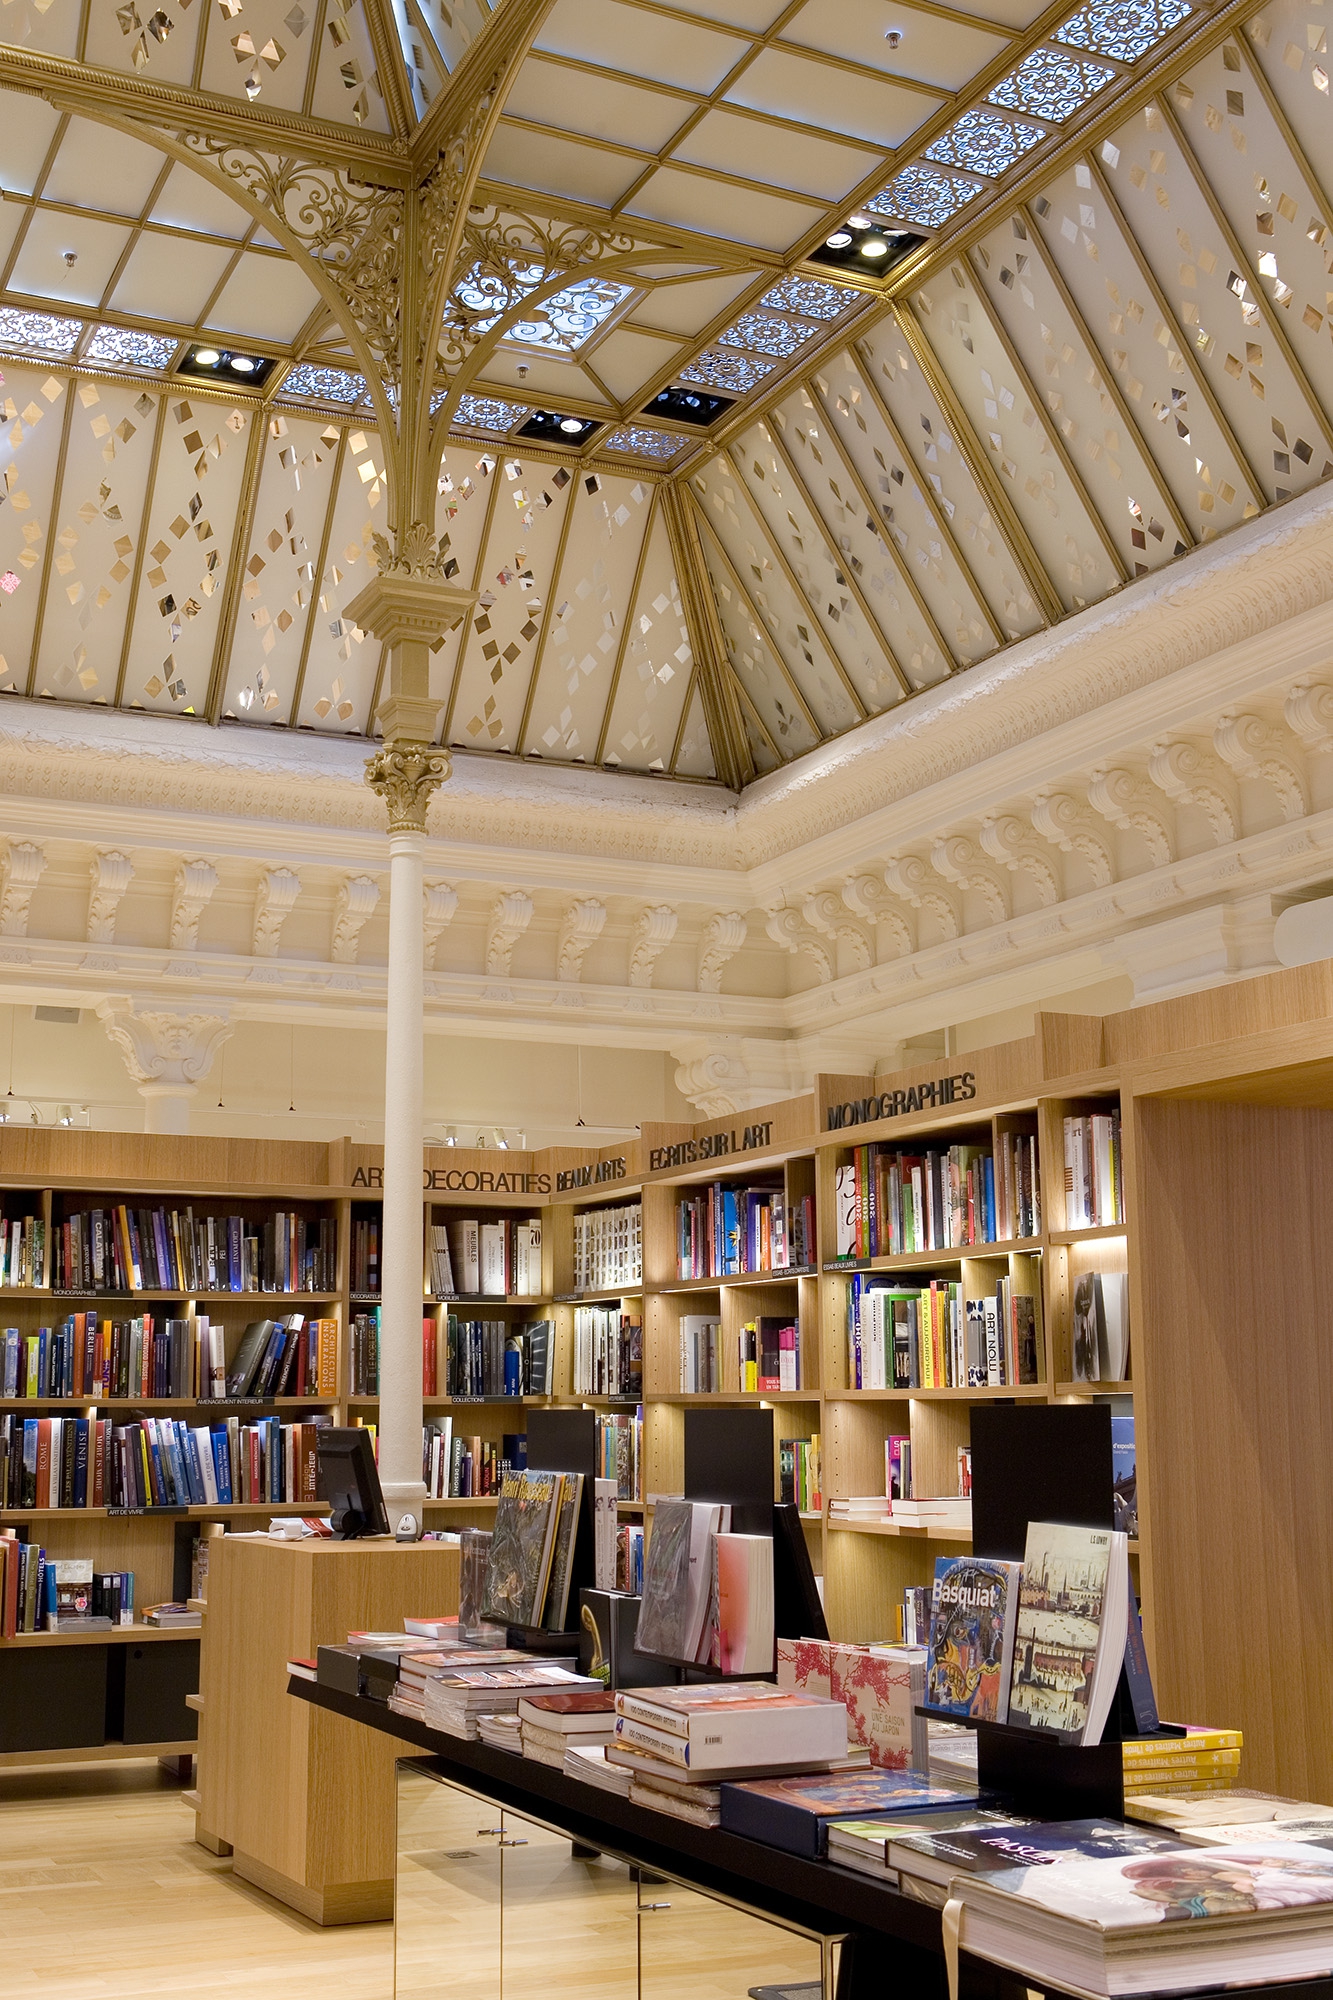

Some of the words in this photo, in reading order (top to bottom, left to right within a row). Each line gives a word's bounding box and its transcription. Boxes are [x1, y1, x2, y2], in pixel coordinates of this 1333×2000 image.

[827, 1072, 976, 1131] MONOGRAPHIES
[650, 1139, 697, 1171] ECRITS
[699, 1132, 729, 1159] SUR
[731, 1130, 741, 1154] L
[742, 1121, 773, 1151] ART
[557, 1165, 593, 1192] BEAUX
[595, 1157, 626, 1183] ARTS
[530, 1229, 541, 1246] 70
[95, 1222, 104, 1278] CALATRAVA
[53, 1289, 97, 1297] MONOGRAPHIES
[987, 1312, 996, 1336] ART
[86, 1326, 95, 1354] BERLIN
[368, 1329, 377, 1361] MOBILIER
[368, 1360, 376, 1370] LE
[988, 1340, 996, 1372] NOW
[102, 1359, 111, 1390] TUNIS
[39, 1442, 48, 1470] ROME
[78, 1431, 87, 1469] VENISE
[95, 1435, 103, 1458] MORE
[203, 1445, 211, 1461] VIVRE
[96, 1459, 102, 1467] IS
[95, 1468, 103, 1492] MORE
[205, 1469, 213, 1481] ART
[932, 1578, 997, 1610] Basquiat
[637, 1707, 662, 1723] CONTEMPORARY
[663, 1716, 677, 1728] ARTISTS
[871, 1711, 883, 1723] UNE
[884, 1714, 906, 1727] SAISON
[871, 1724, 880, 1734] AU
[881, 1726, 900, 1736] JAPON
[635, 1731, 660, 1748] CONTEMPORARY
[661, 1742, 674, 1755] ARTISTS
[1145, 1744, 1154, 1752] de
[1155, 1741, 1182, 1751] Maîtres
[1182, 1739, 1206, 1748] Autres
[1171, 1755, 1197, 1765] Autres
[1134, 1775, 1143, 1783] de
[1174, 1769, 1198, 1778] Autres
